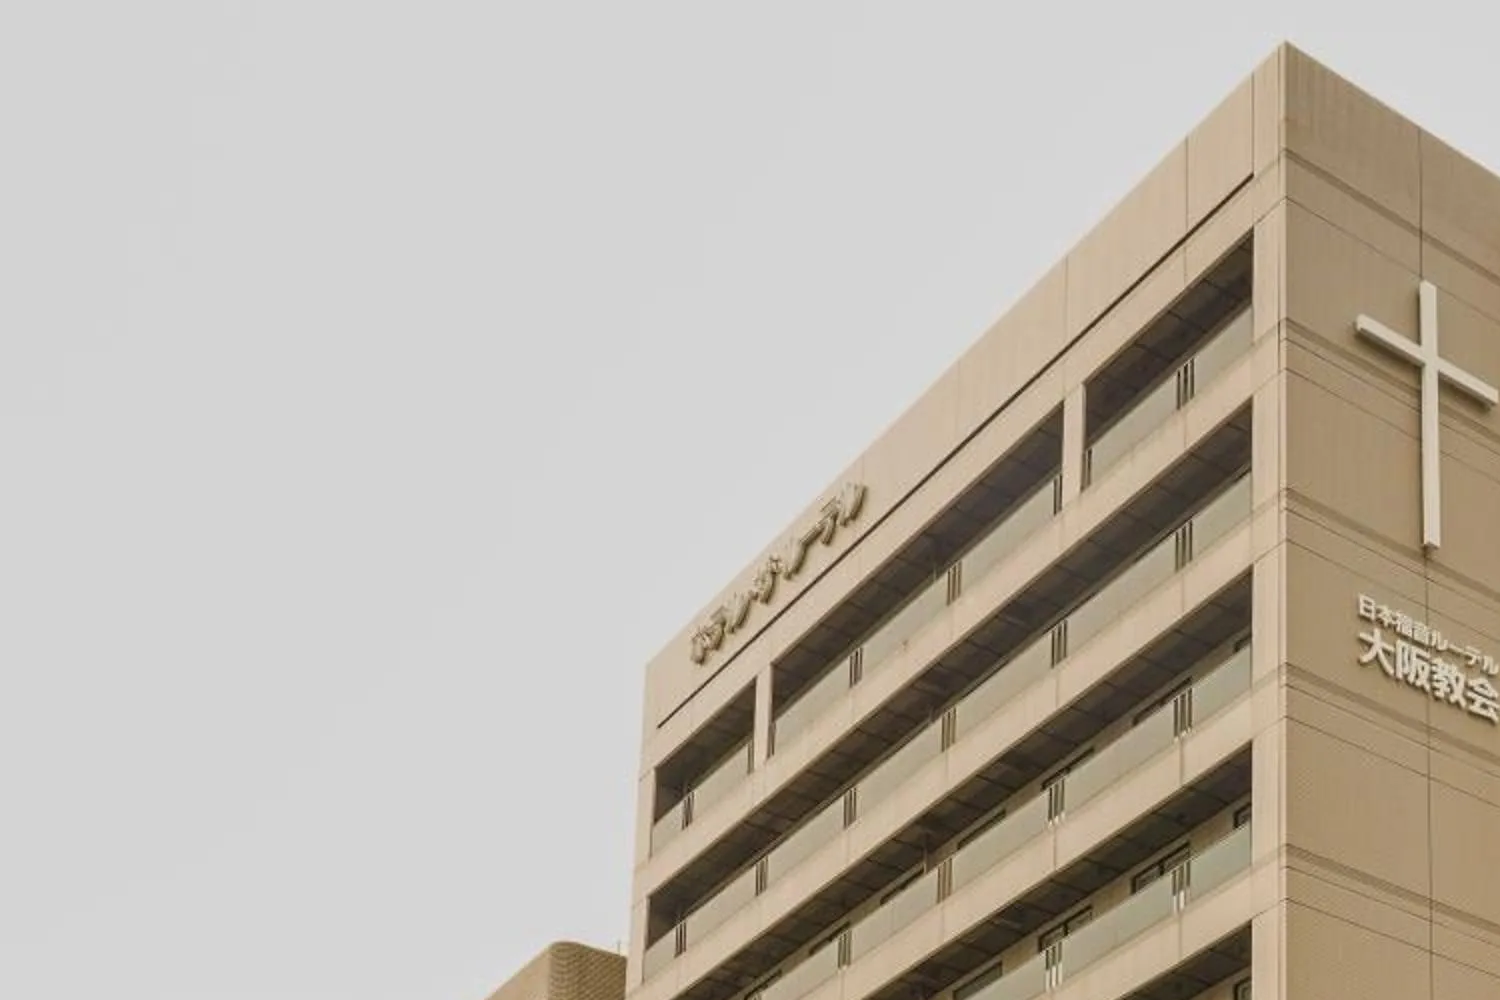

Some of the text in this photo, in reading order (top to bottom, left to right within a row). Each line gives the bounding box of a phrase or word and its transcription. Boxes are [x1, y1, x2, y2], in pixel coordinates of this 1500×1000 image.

[1358, 593, 1500, 675] 日本福音ルーテル
[1358, 628, 1500, 724] 大阪教会
